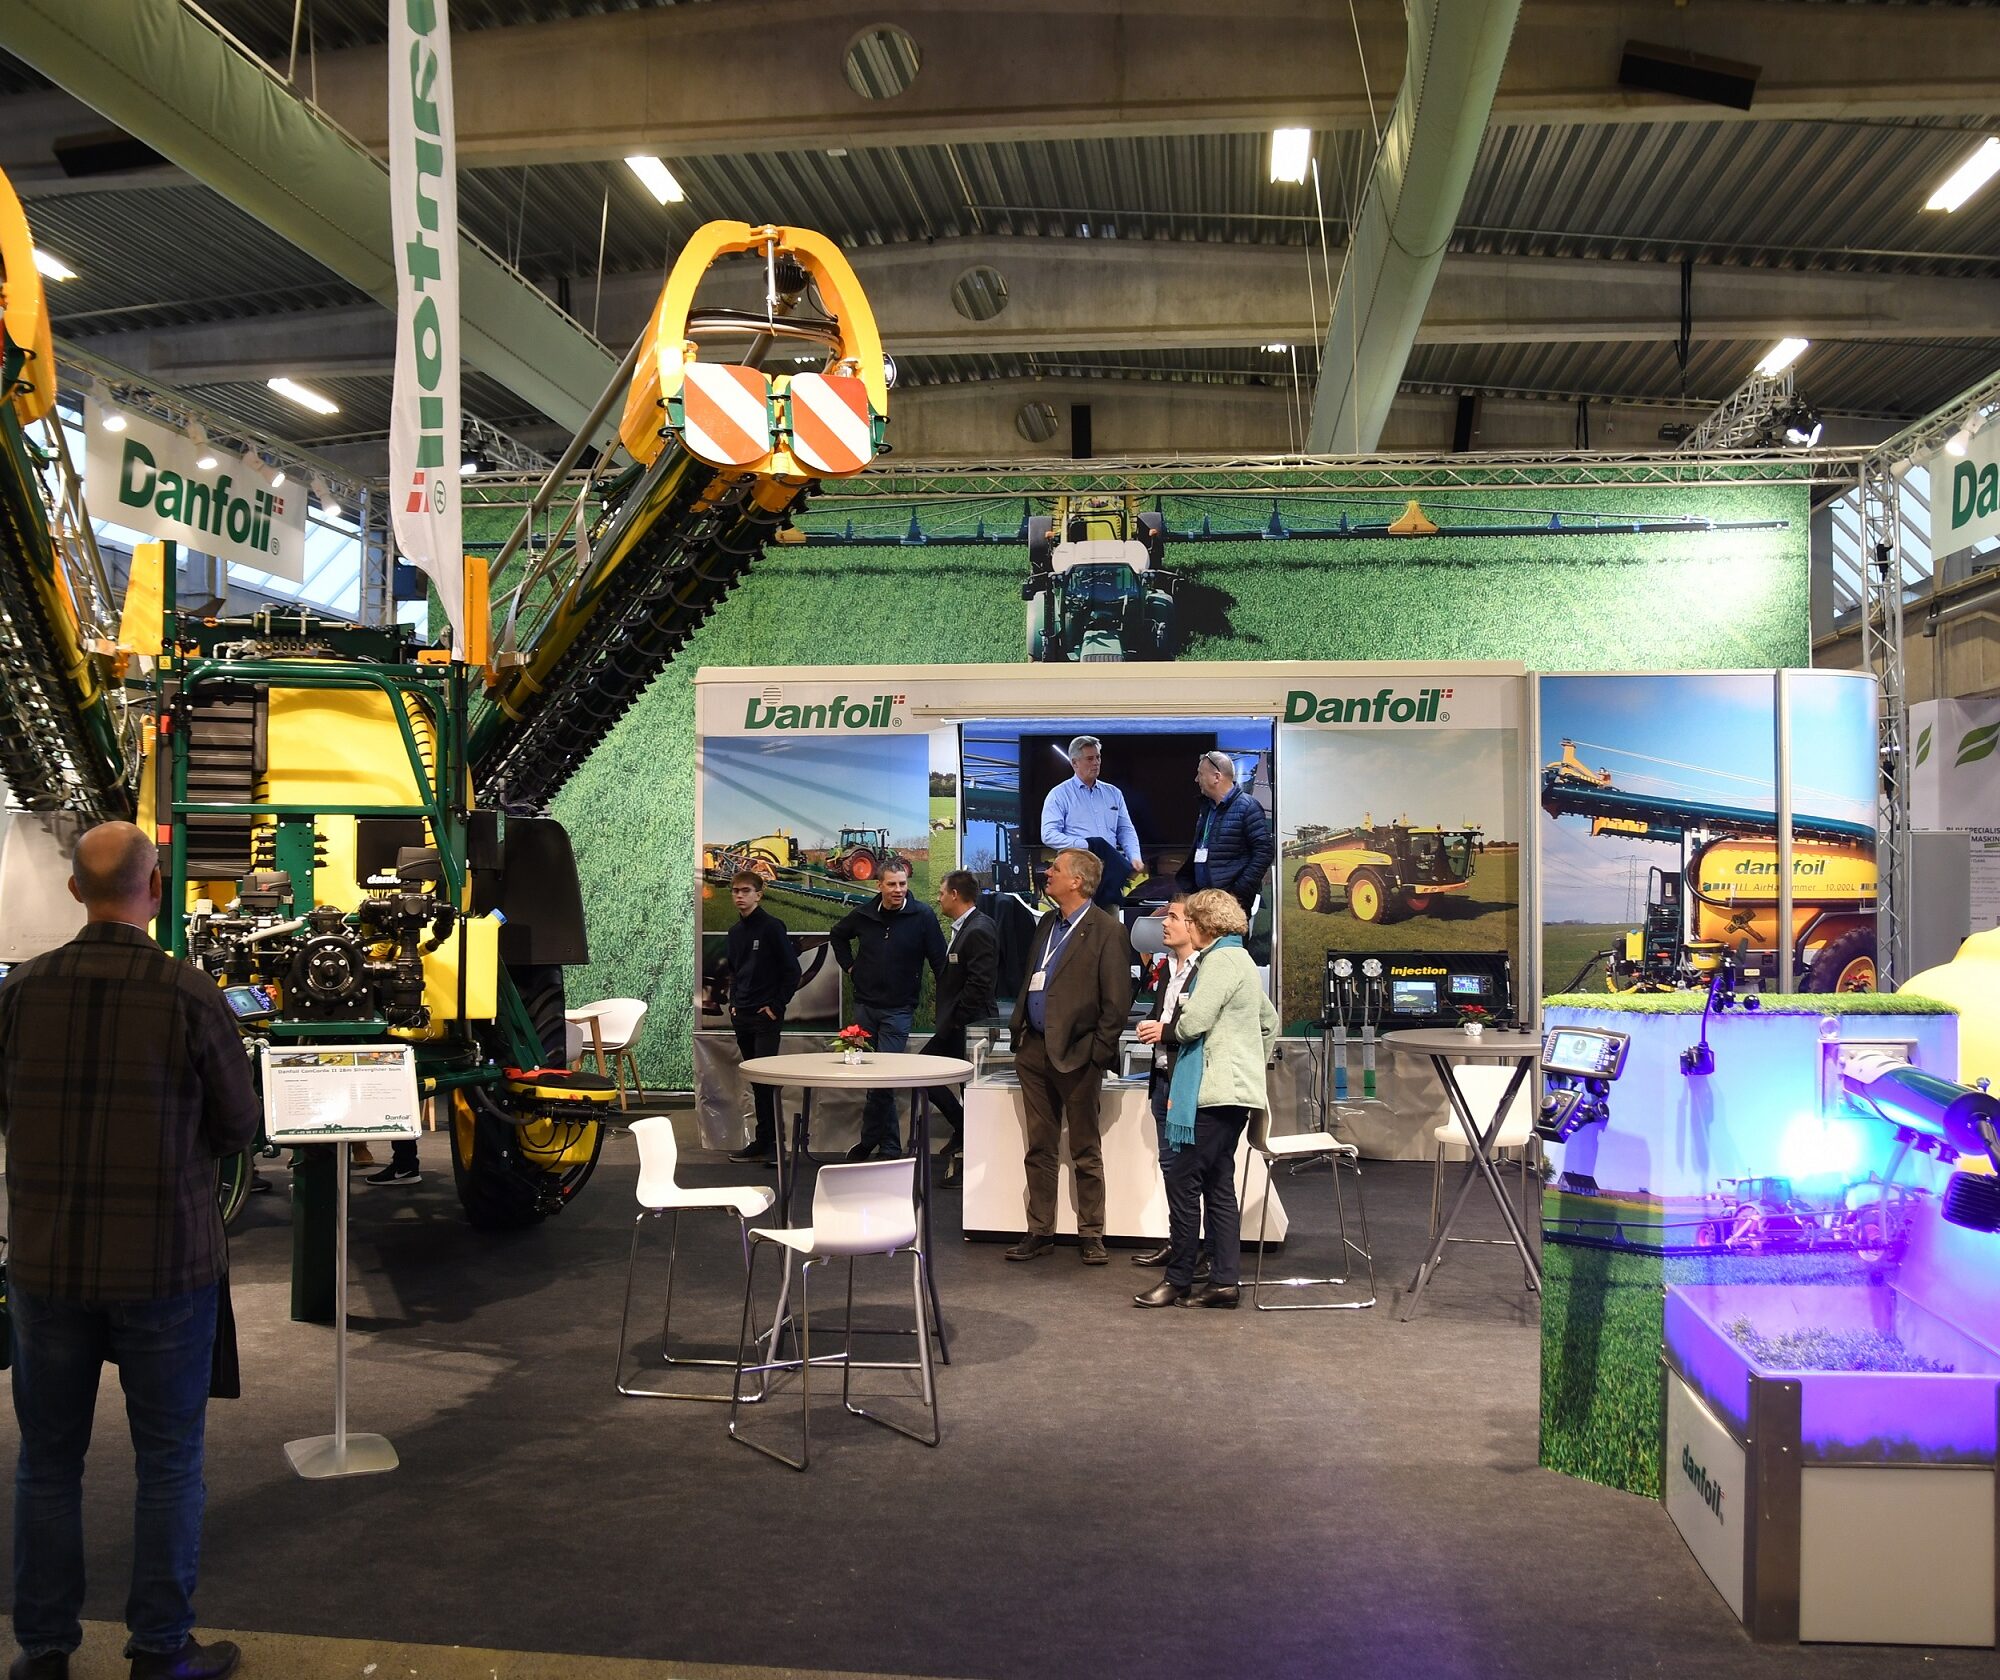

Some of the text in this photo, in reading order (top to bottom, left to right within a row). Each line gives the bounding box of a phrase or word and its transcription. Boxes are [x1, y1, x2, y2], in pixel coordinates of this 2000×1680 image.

[119, 438, 272, 552] Danfoil
[1951, 460, 2000, 530] Da
[1283, 689, 1441, 724] Danfoil
[1391, 967, 1447, 976] injection
[1682, 1443, 1722, 1518] danfoil
